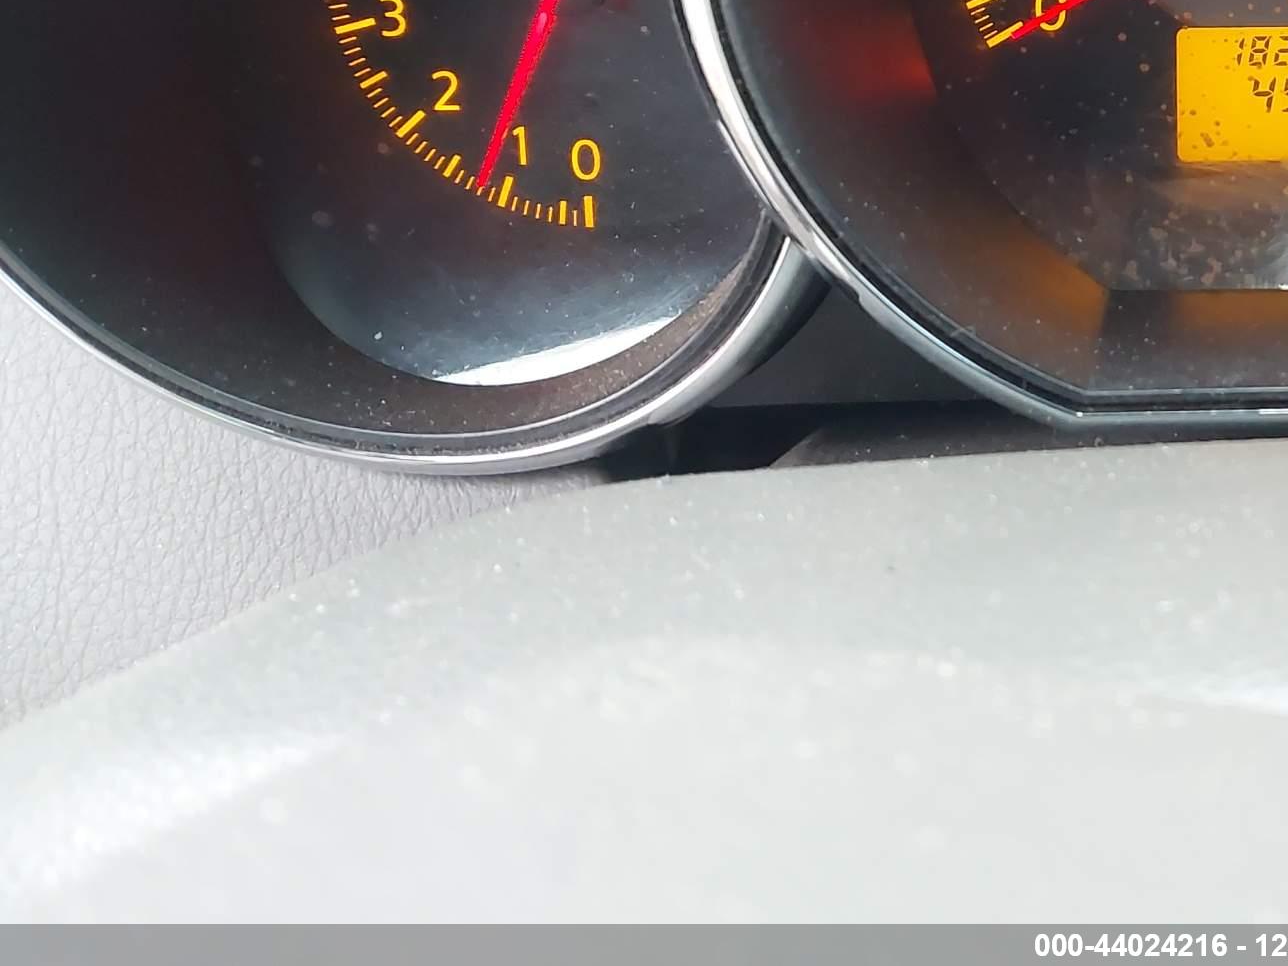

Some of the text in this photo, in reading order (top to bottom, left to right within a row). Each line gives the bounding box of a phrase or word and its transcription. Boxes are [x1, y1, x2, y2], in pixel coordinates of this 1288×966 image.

[430, 70, 461, 112] 2
[512, 125, 528, 166] 1
[570, 138, 602, 181] 0
